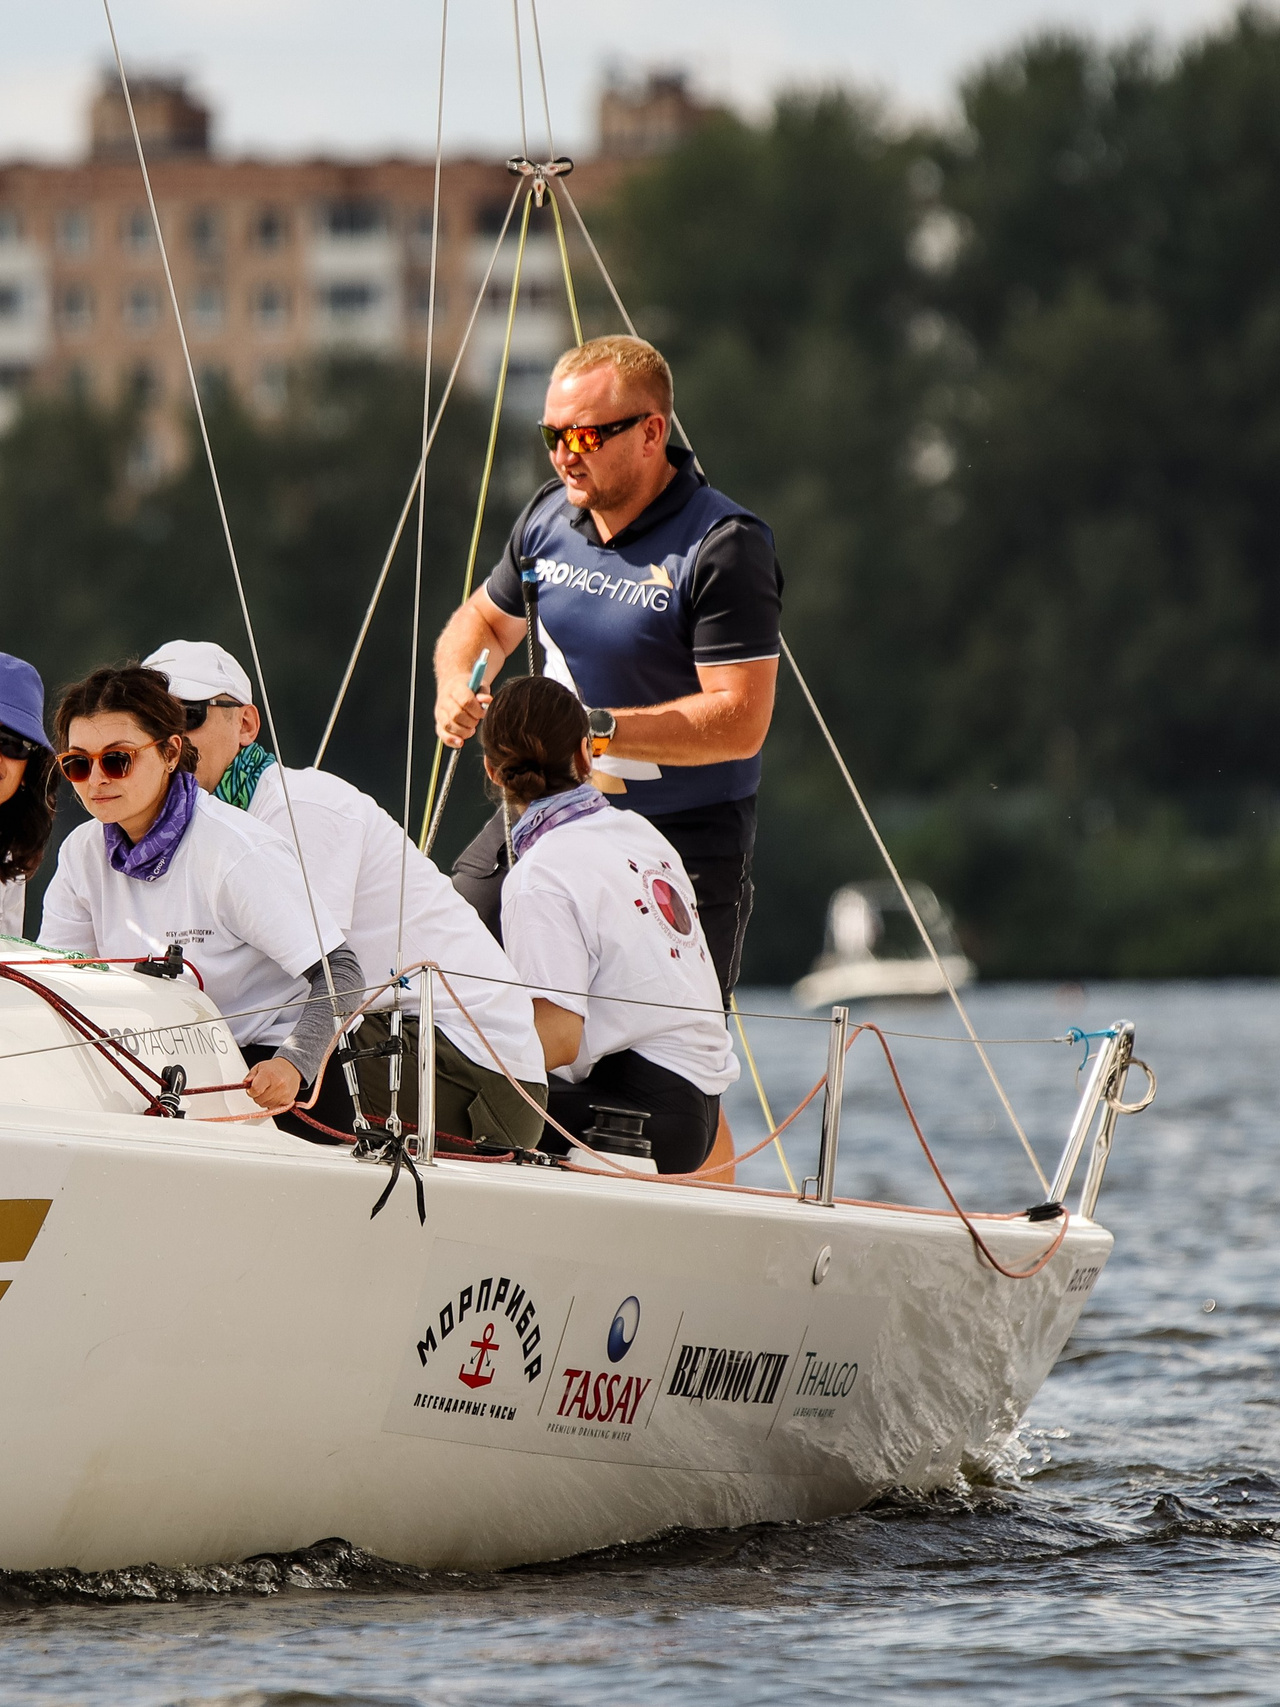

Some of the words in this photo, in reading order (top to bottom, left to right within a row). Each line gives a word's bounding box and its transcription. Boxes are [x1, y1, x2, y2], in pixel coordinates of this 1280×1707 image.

[416, 1276, 542, 1384] МОРПРИБОР
[556, 1368, 653, 1425] TASSAY
[666, 1344, 790, 1407] ВЕДОМОСТИ
[413, 1393, 487, 1417] ЛЕГЕНДАРНЫЕ
[489, 1404, 518, 1421] ЧАСЫ
[546, 1422, 577, 1435] PREMIUM
[578, 1426, 610, 1440] DRINKING
[611, 1430, 632, 1442] WATER
